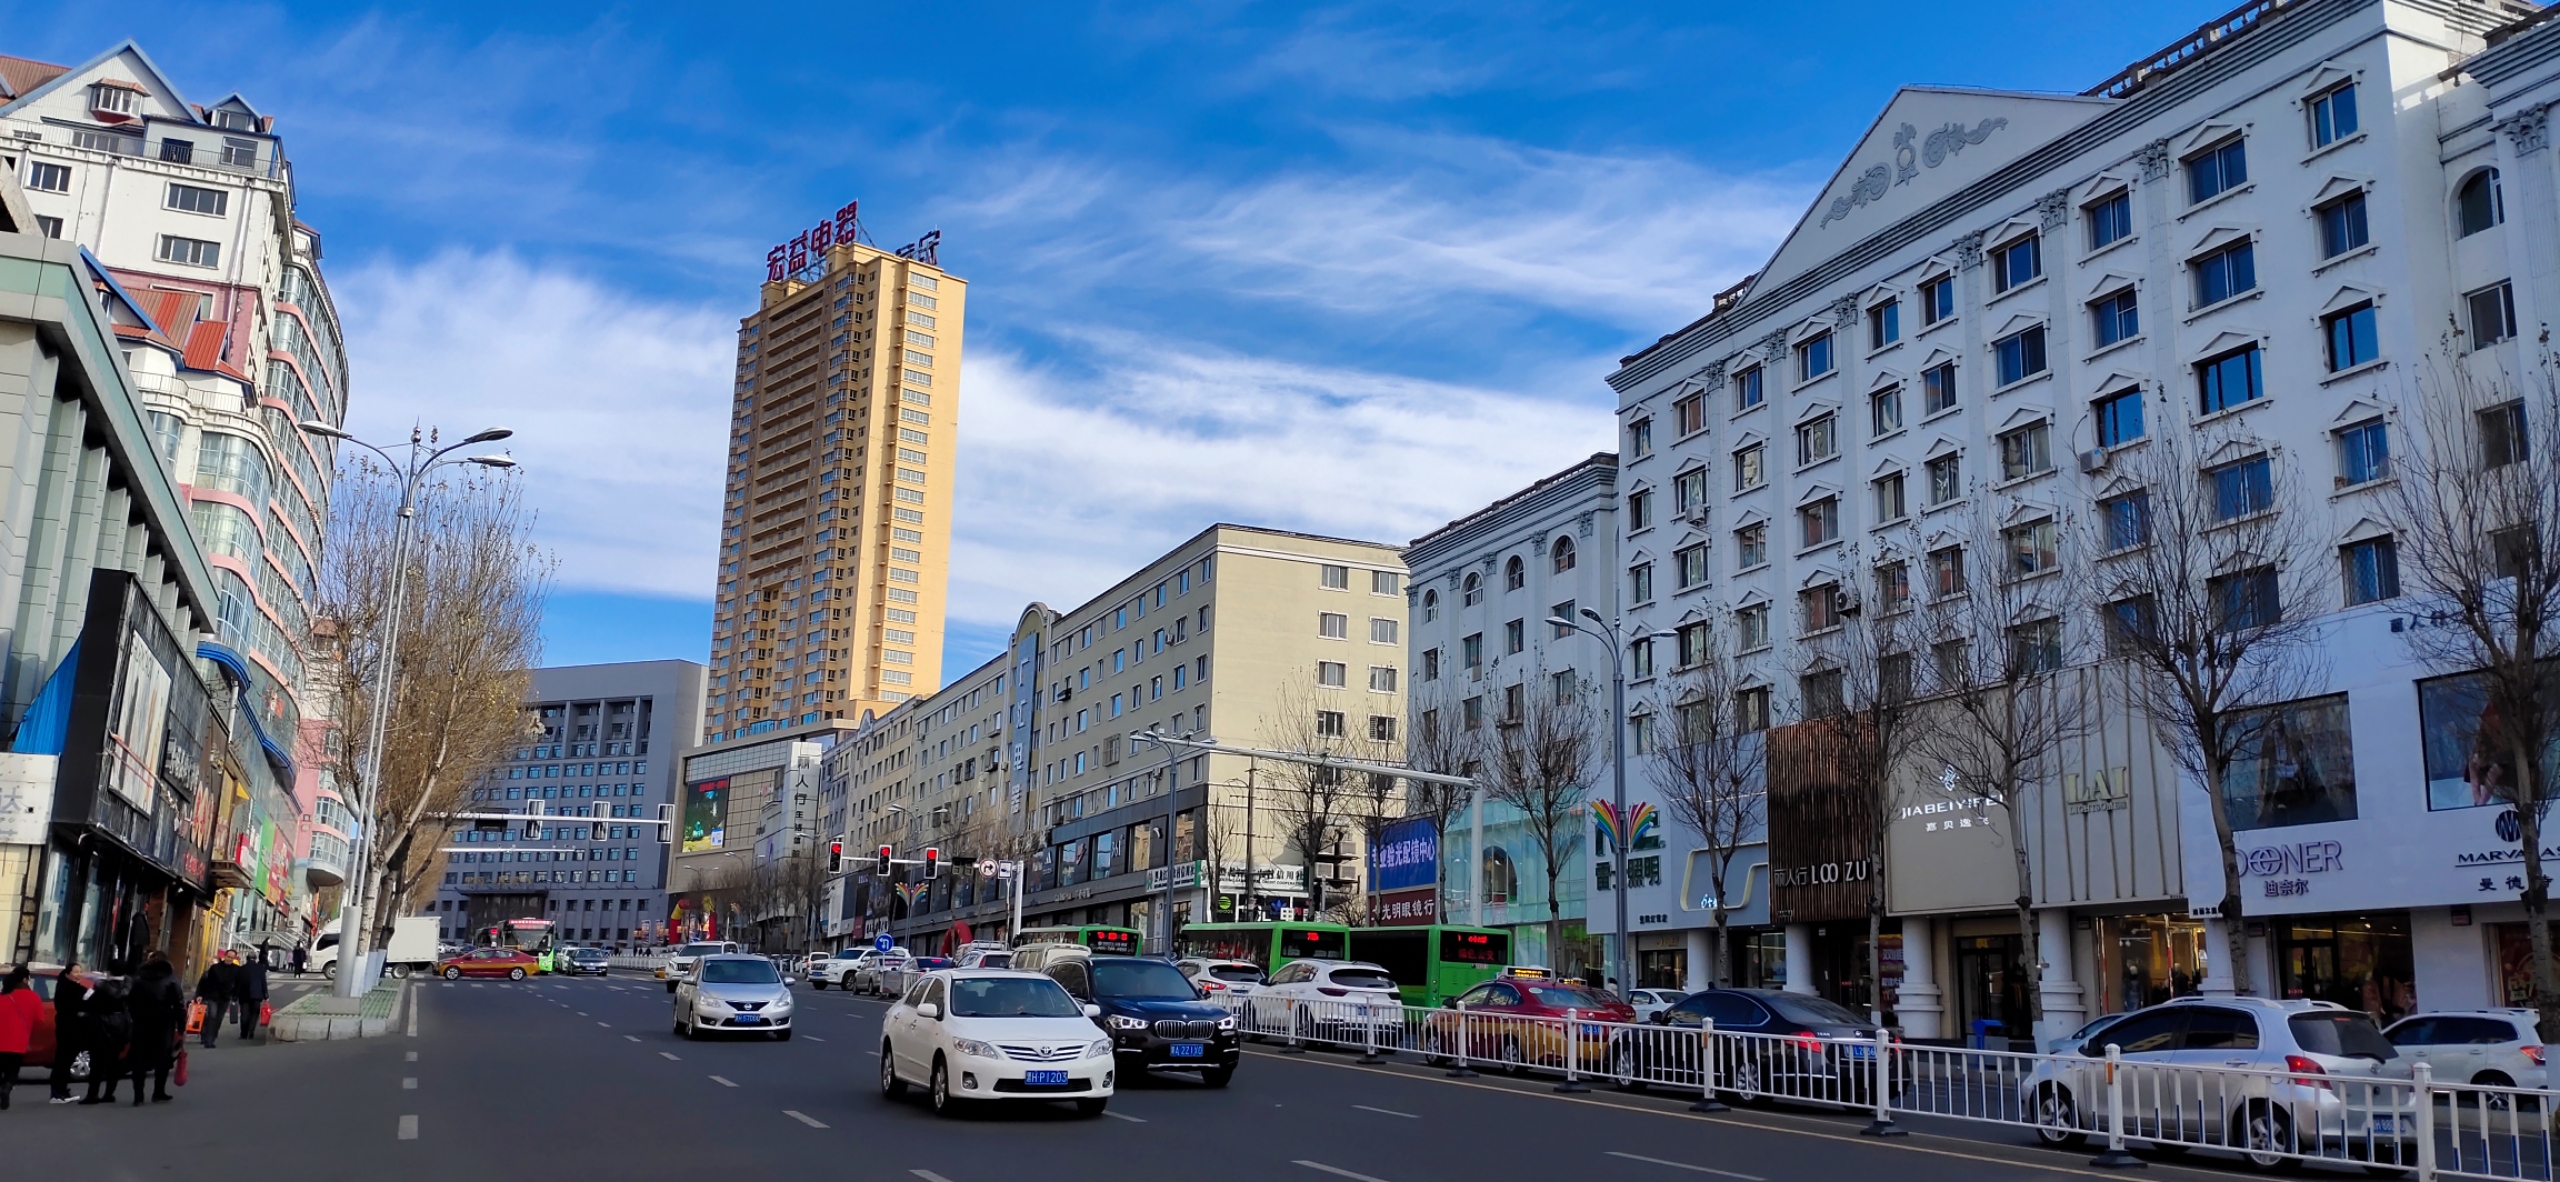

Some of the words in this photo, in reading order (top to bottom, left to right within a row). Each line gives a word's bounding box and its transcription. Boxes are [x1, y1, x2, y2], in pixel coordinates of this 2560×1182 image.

[767, 201, 857, 281] 宏益电器
[2065, 767, 2128, 804] LAI
[1595, 854, 1662, 891] 雷照明
[1774, 867, 1808, 887] 丽人行
[1811, 862, 1839, 884] LOO
[2264, 878, 2309, 897] 迪奈尔
